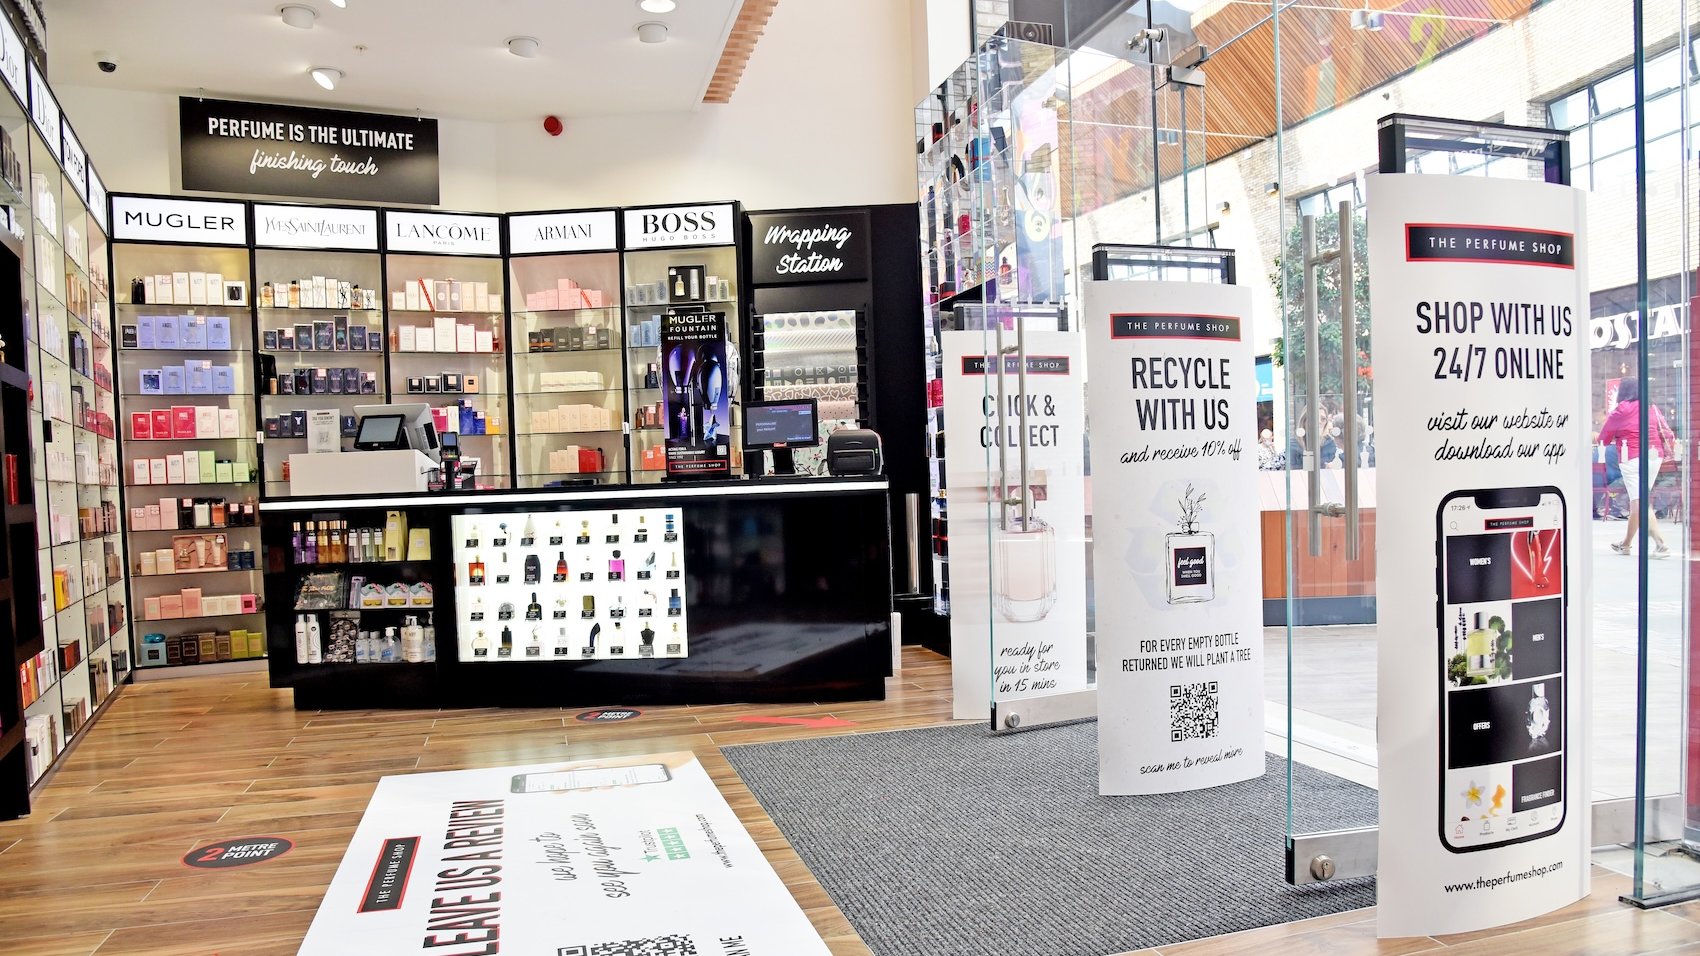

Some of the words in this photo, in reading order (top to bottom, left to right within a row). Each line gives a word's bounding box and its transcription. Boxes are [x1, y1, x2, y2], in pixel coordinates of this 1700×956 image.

[208, 117, 284, 140] PERFUME
[289, 124, 304, 142] IS
[308, 126, 337, 144] THE
[342, 128, 414, 150] ULTIMATE
[250, 149, 326, 178] finishing
[330, 154, 378, 176] touch
[124, 211, 234, 230] MUGLER
[642, 211, 716, 234] BOSS
[397, 223, 490, 241] LANCÔME
[534, 224, 592, 241] ARMANI
[764, 223, 852, 250] Wrapping
[1429, 237, 1456, 248] THE
[1466, 238, 1525, 252] PERFUME
[1532, 242, 1562, 255] SHOP
[776, 252, 843, 274] Station
[669, 315, 716, 324] MUGLER
[1128, 322, 1147, 330] THE
[1155, 322, 1200, 331] PERFUME
[1206, 324, 1230, 332] SHOP
[1416, 301, 1484, 334] SHOP
[1491, 302, 1545, 335] WITH
[1552, 305, 1572, 336] US
[1131, 357, 1230, 389] RECYCLE
[1434, 344, 1486, 382] 24/7
[1495, 348, 1564, 379] ONLINE
[982, 394, 1038, 418] CICK
[1044, 394, 1056, 416] &
[1136, 399, 1195, 430] WITH
[1204, 399, 1229, 430] US
[1428, 407, 1468, 431] visit
[1471, 415, 1498, 430] our
[1502, 406, 1554, 430] website
[1556, 414, 1569, 428] or
[980, 425, 1059, 448] COLECT
[1120, 445, 1150, 464] and
[1152, 444, 1198, 461] receive
[1202, 440, 1225, 457] 10%
[1228, 439, 1242, 461] off
[1434, 436, 1513, 460] download
[1517, 443, 1540, 458] our
[1544, 445, 1566, 464] app
[1189, 556, 1204, 568] good
[1000, 641, 1036, 661] ready
[1037, 640, 1054, 660] for
[1140, 640, 1157, 653] FOR
[1160, 638, 1186, 651] EVERY
[1188, 635, 1212, 649] EMPTY
[1215, 632, 1239, 647] BOTTLE
[994, 664, 1017, 681] you
[1020, 661, 1031, 674] in
[1034, 658, 1060, 673] store
[1122, 658, 1167, 672] RETURNED
[1171, 657, 1183, 668] WE
[1185, 654, 1205, 667] WILL
[1207, 652, 1228, 665] PLANT
[1230, 651, 1235, 662] A
[1236, 648, 1251, 661] TREE
[999, 680, 1012, 693] in
[1015, 678, 1028, 692] 15
[1031, 677, 1056, 691] mins
[1473, 721, 1490, 730] OFFERS
[1140, 764, 1165, 774] scan
[1166, 761, 1181, 771] me
[1184, 756, 1194, 768] to
[1195, 749, 1222, 766] reveal
[1224, 747, 1243, 759] more
[1521, 792, 1542, 803] FRAGRANCE
[1542, 789, 1555, 798] FINDER
[443, 800, 504, 849] REVIEW
[571, 813, 596, 831] soon
[528, 832, 562, 842] to
[573, 833, 622, 857] again
[638, 830, 658, 854] Trustpilot
[197, 848, 224, 862] 2
[228, 842, 279, 852] METRE
[221, 849, 274, 859] POINT
[392, 844, 405, 859] SHOP
[441, 849, 503, 861] A
[536, 842, 581, 864] hope
[382, 861, 400, 887] PERFUME
[435, 865, 502, 892] US
[552, 865, 577, 881] we
[592, 858, 641, 878] you
[1444, 860, 1563, 893] www.theperfumeshop.com
[376, 890, 391, 903] THE
[601, 880, 630, 898] see
